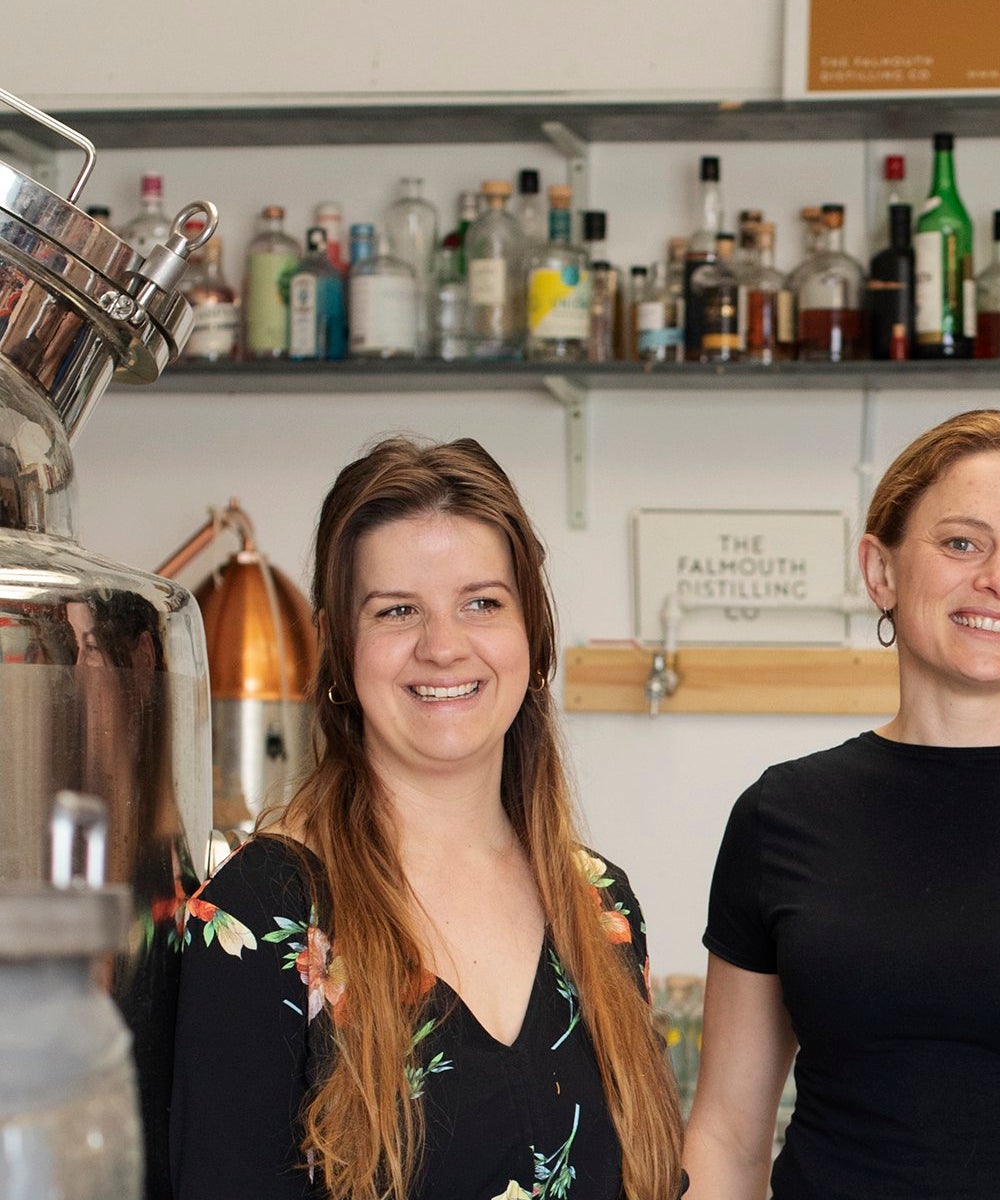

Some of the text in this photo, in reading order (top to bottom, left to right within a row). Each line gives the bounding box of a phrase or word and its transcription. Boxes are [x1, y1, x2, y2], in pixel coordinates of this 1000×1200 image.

[820, 56, 934, 67] THE FALMOUTH
[819, 69, 929, 81] DISTILLING CO
[720, 534, 764, 555] THE
[676, 556, 808, 577] FALMOUTH
[676, 579, 808, 600] DISTILLING
